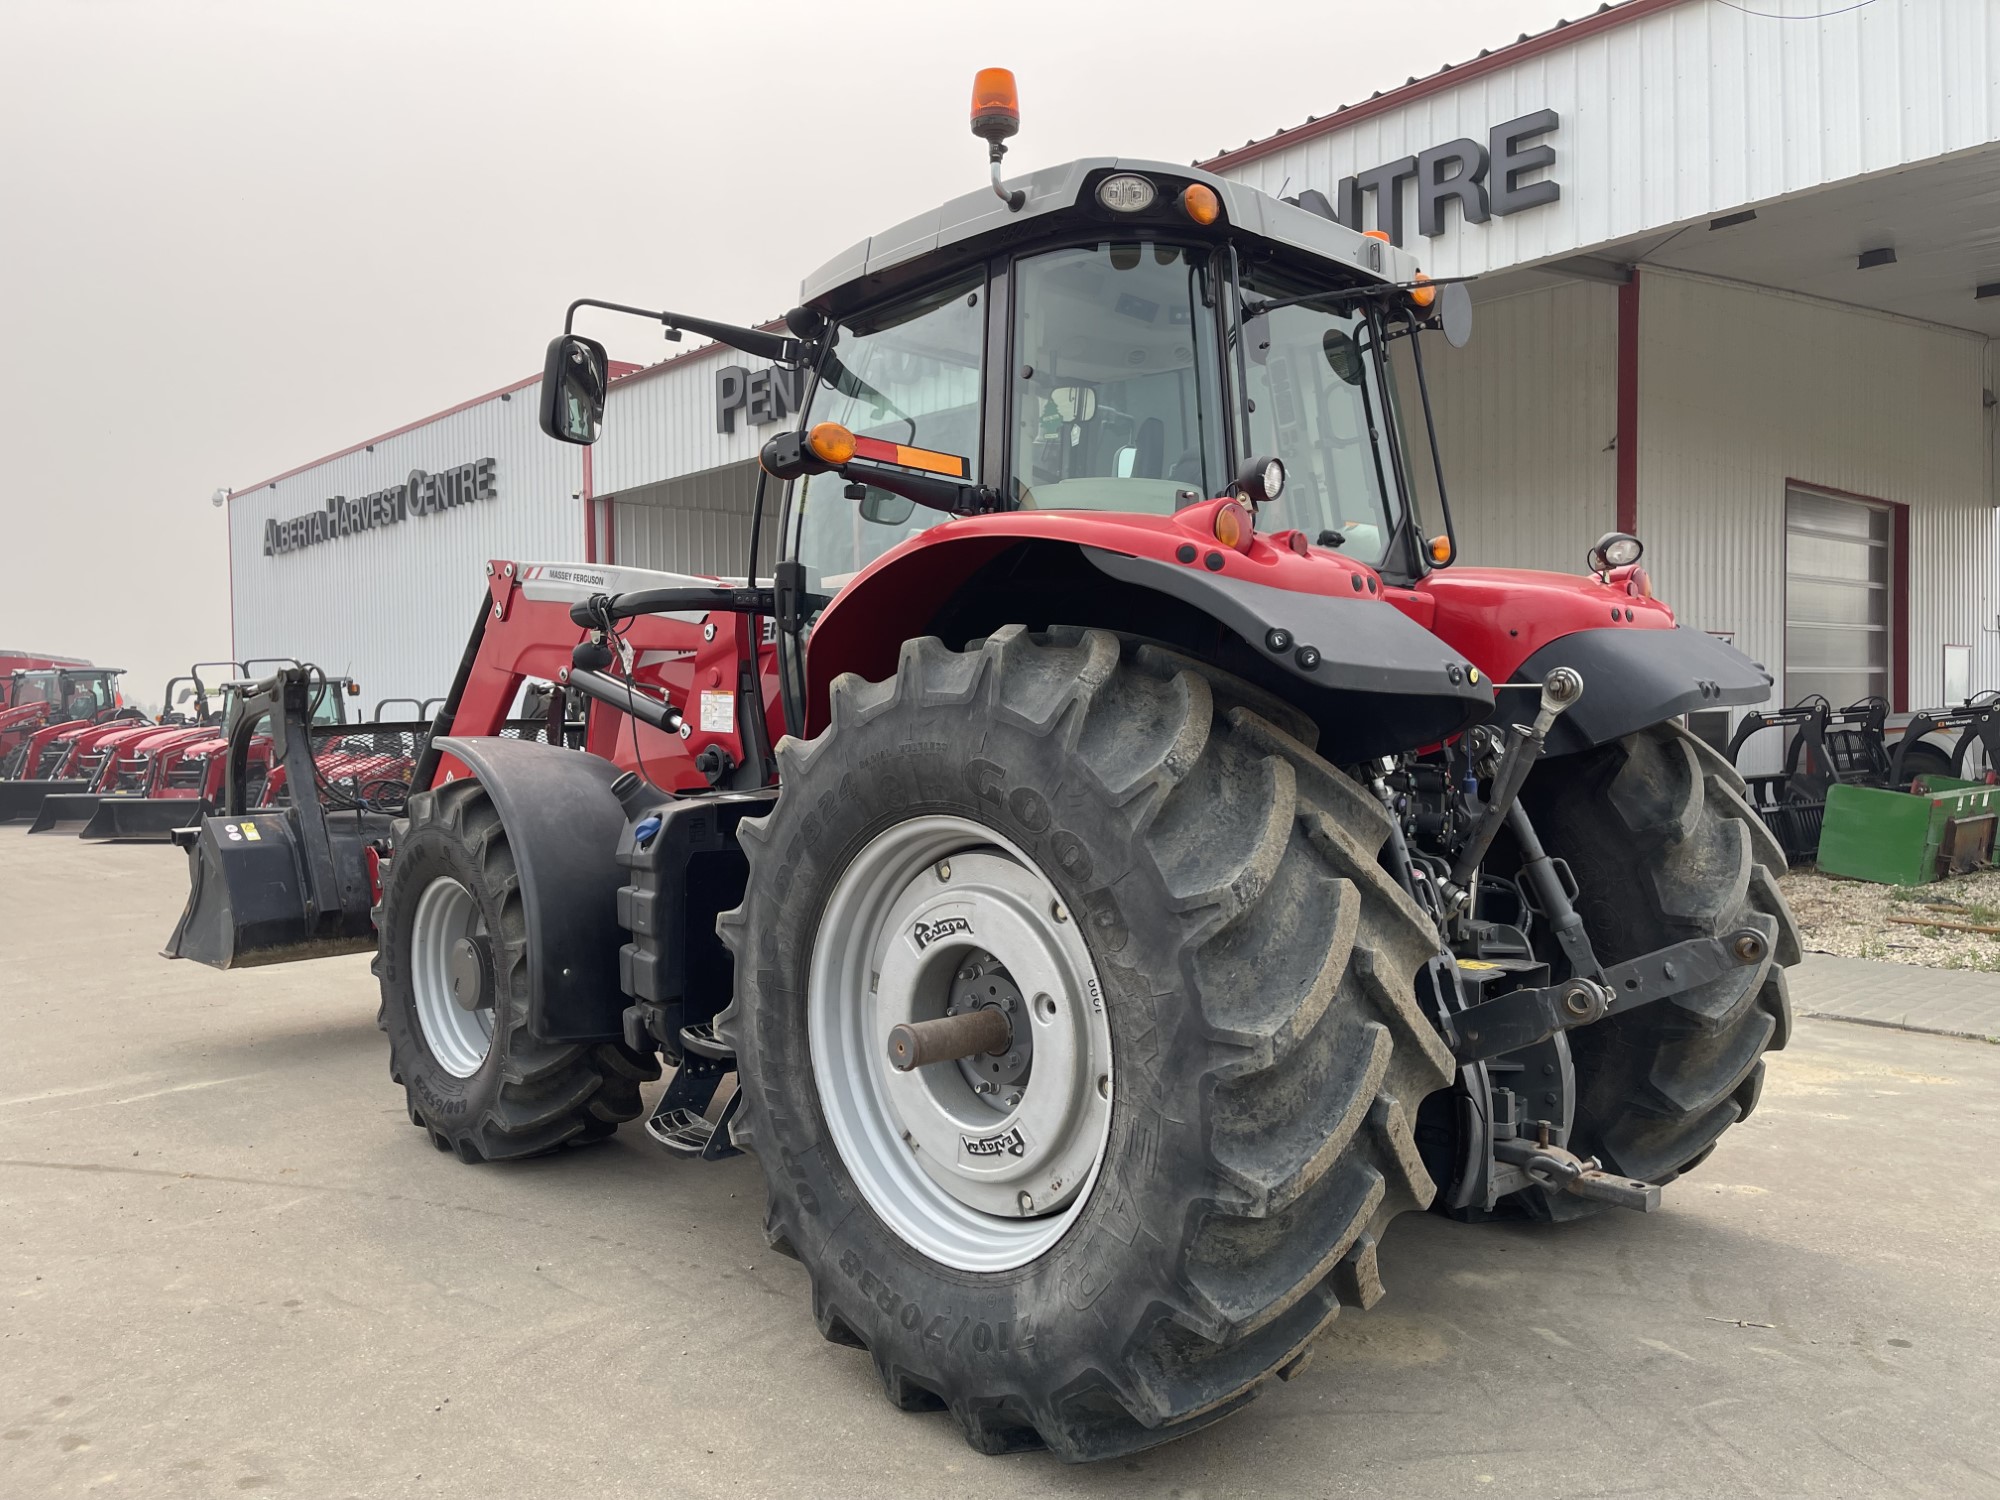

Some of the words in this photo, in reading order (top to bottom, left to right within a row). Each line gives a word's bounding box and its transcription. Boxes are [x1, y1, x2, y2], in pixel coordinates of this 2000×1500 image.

[1281, 108, 1560, 247] NTRE
[264, 518, 326, 556] ALBERTA
[326, 495, 407, 539] HARVEST
[406, 457, 497, 517] CENTRE
[549, 569, 572, 582] MASSEY
[573, 573, 604, 586] FERGUSON
[838, 1248, 1036, 1354] 710/70R38
